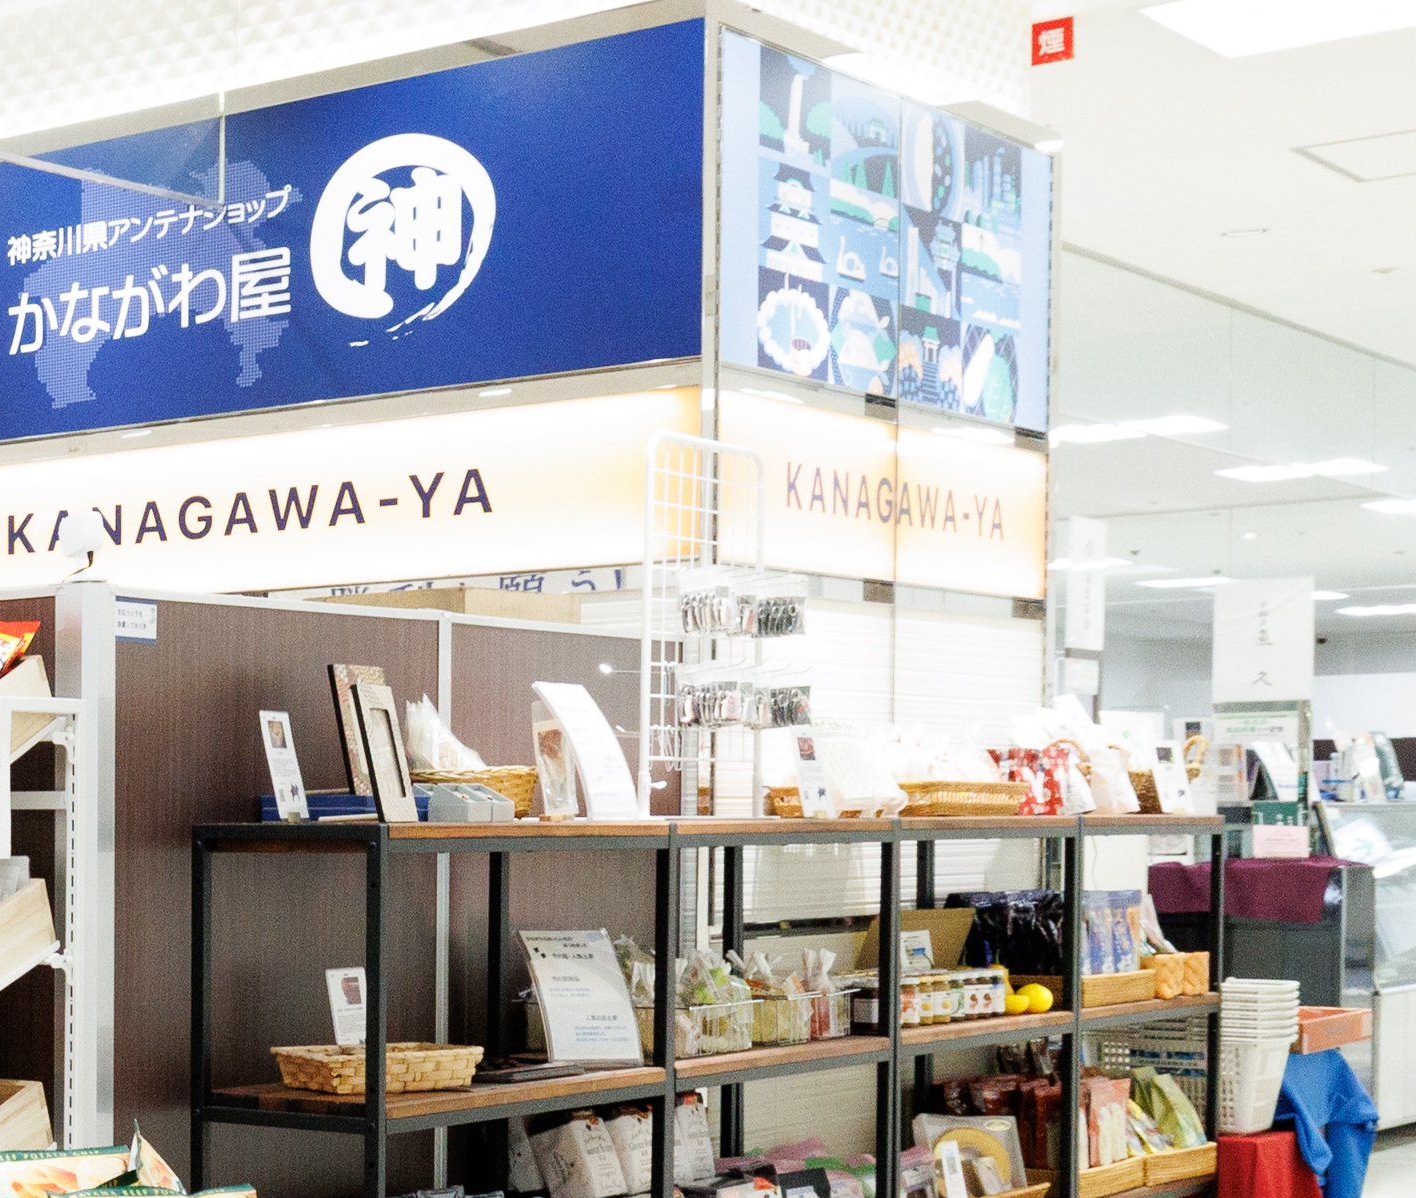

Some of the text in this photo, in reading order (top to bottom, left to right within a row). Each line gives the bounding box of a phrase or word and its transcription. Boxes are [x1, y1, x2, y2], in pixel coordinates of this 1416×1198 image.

[1038, 27, 1066, 57] 煙
[7, 184, 292, 266] 神奈川県アンテナショップ
[8, 246, 292, 356] かながわ屋
[786, 461, 1004, 540] KANAGAWA-YA
